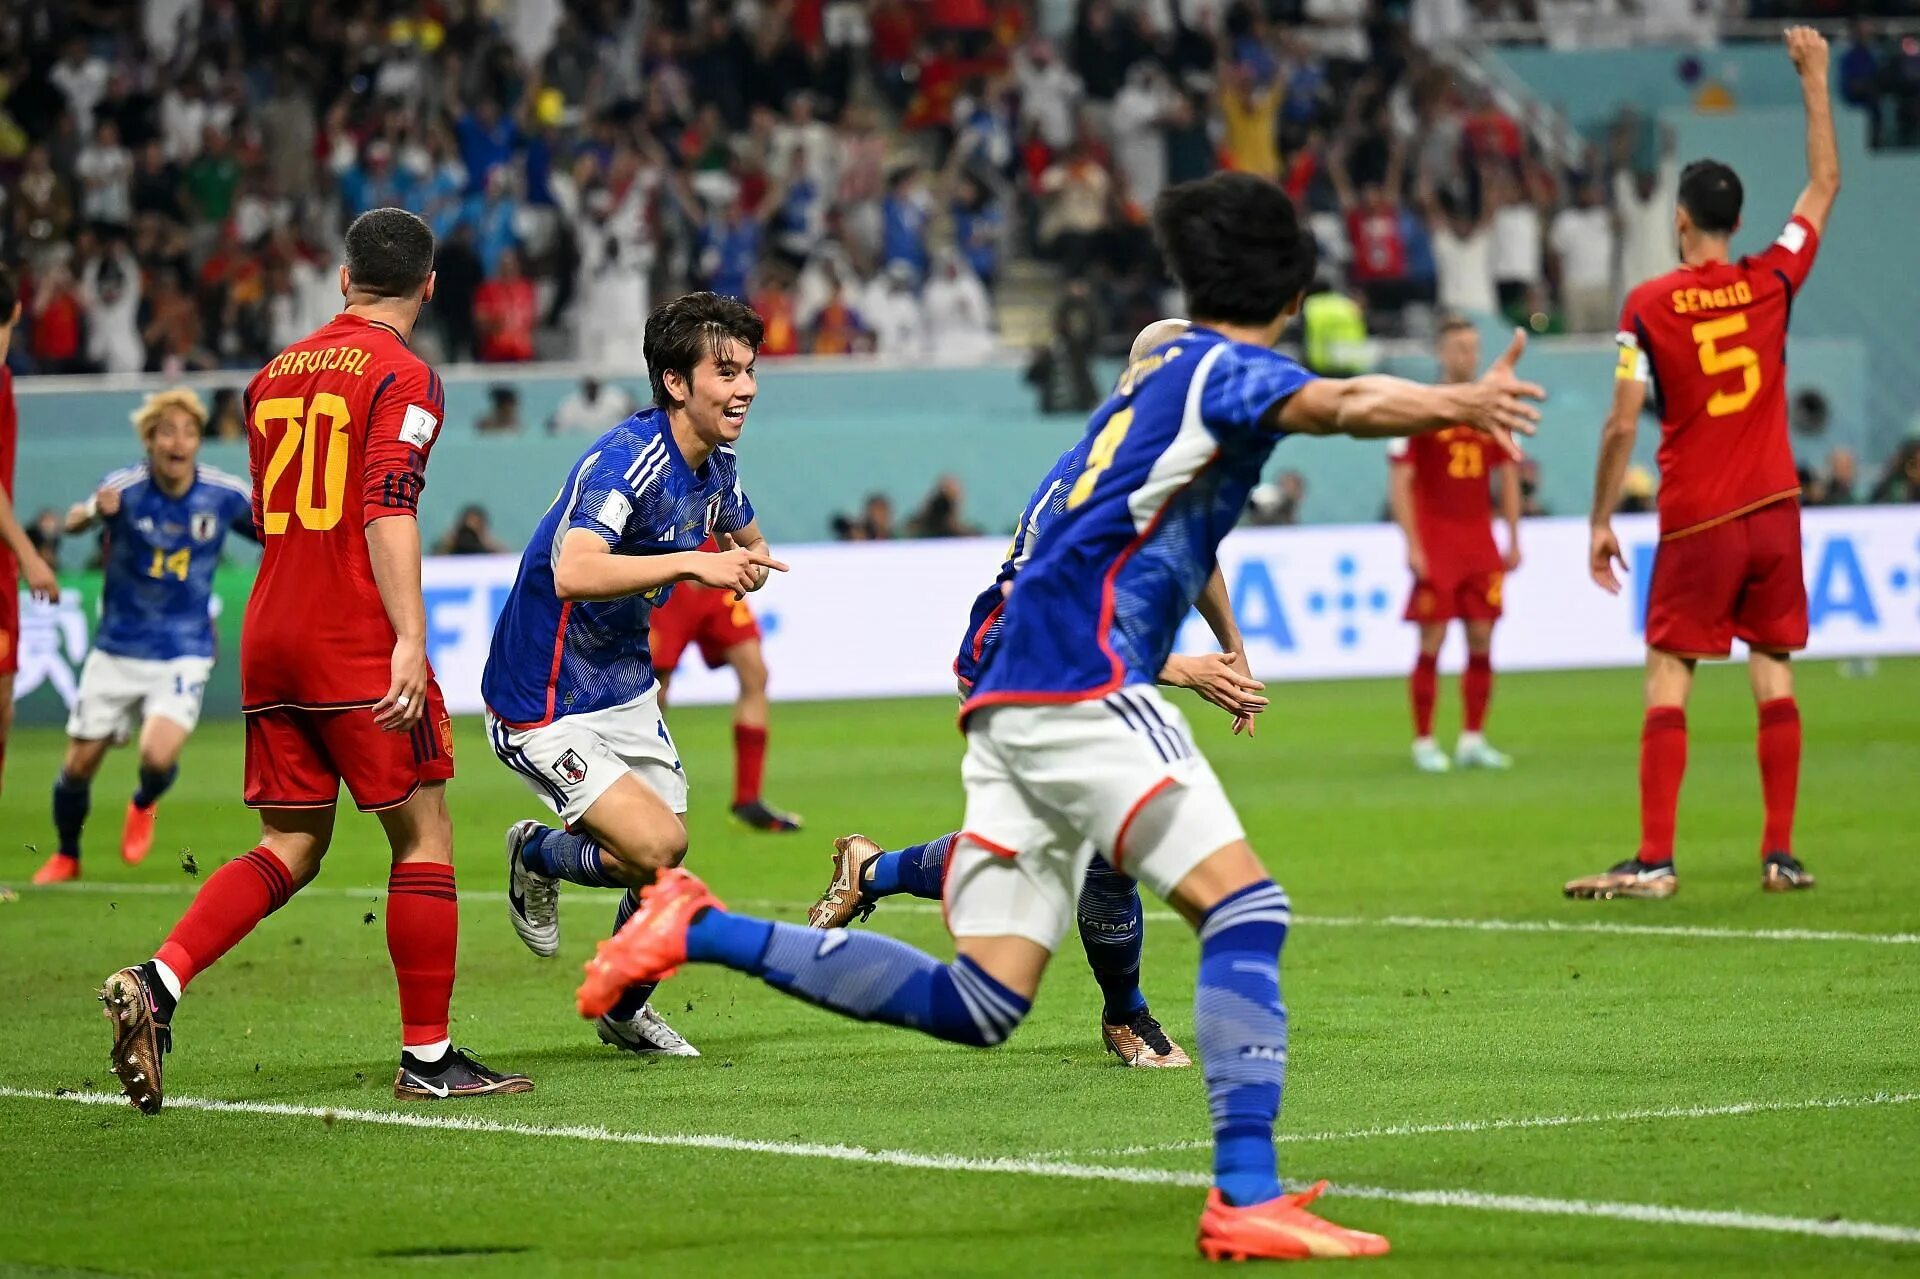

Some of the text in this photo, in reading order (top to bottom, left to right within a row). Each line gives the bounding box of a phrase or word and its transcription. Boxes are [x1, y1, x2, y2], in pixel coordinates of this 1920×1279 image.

[1672, 281, 1752, 313] SERGIO
[268, 346, 371, 378] CARVAJAL
[1692, 312, 1761, 417] 5
[254, 393, 350, 534] 20
[149, 547, 191, 582] 14
